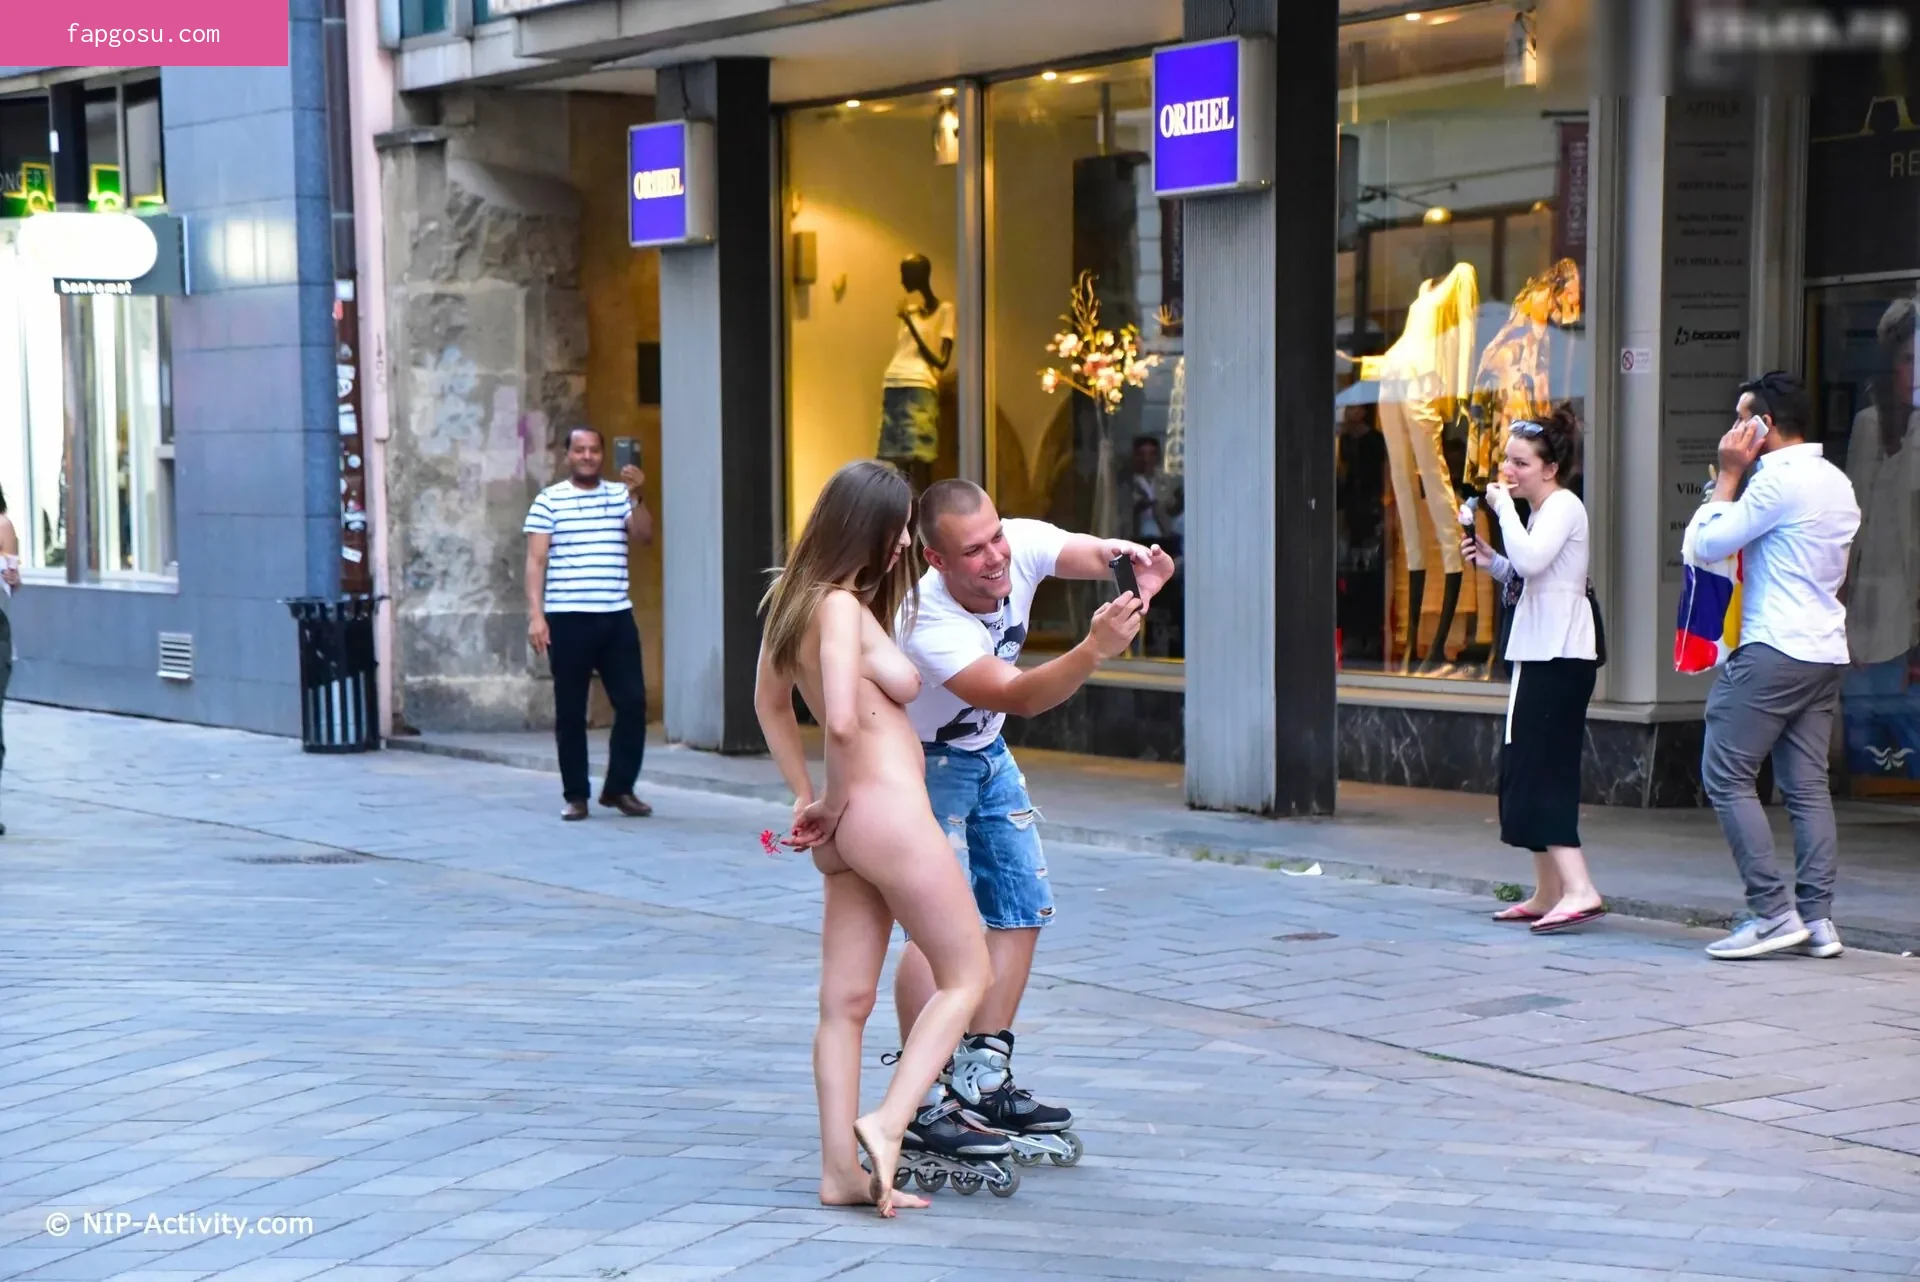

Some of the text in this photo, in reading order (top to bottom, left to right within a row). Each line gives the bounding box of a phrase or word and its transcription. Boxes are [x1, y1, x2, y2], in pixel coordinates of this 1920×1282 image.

[1159, 96, 1235, 138] ORIHEL
[633, 167, 684, 200] ORIHEL
[60, 280, 132, 295] bankomat
